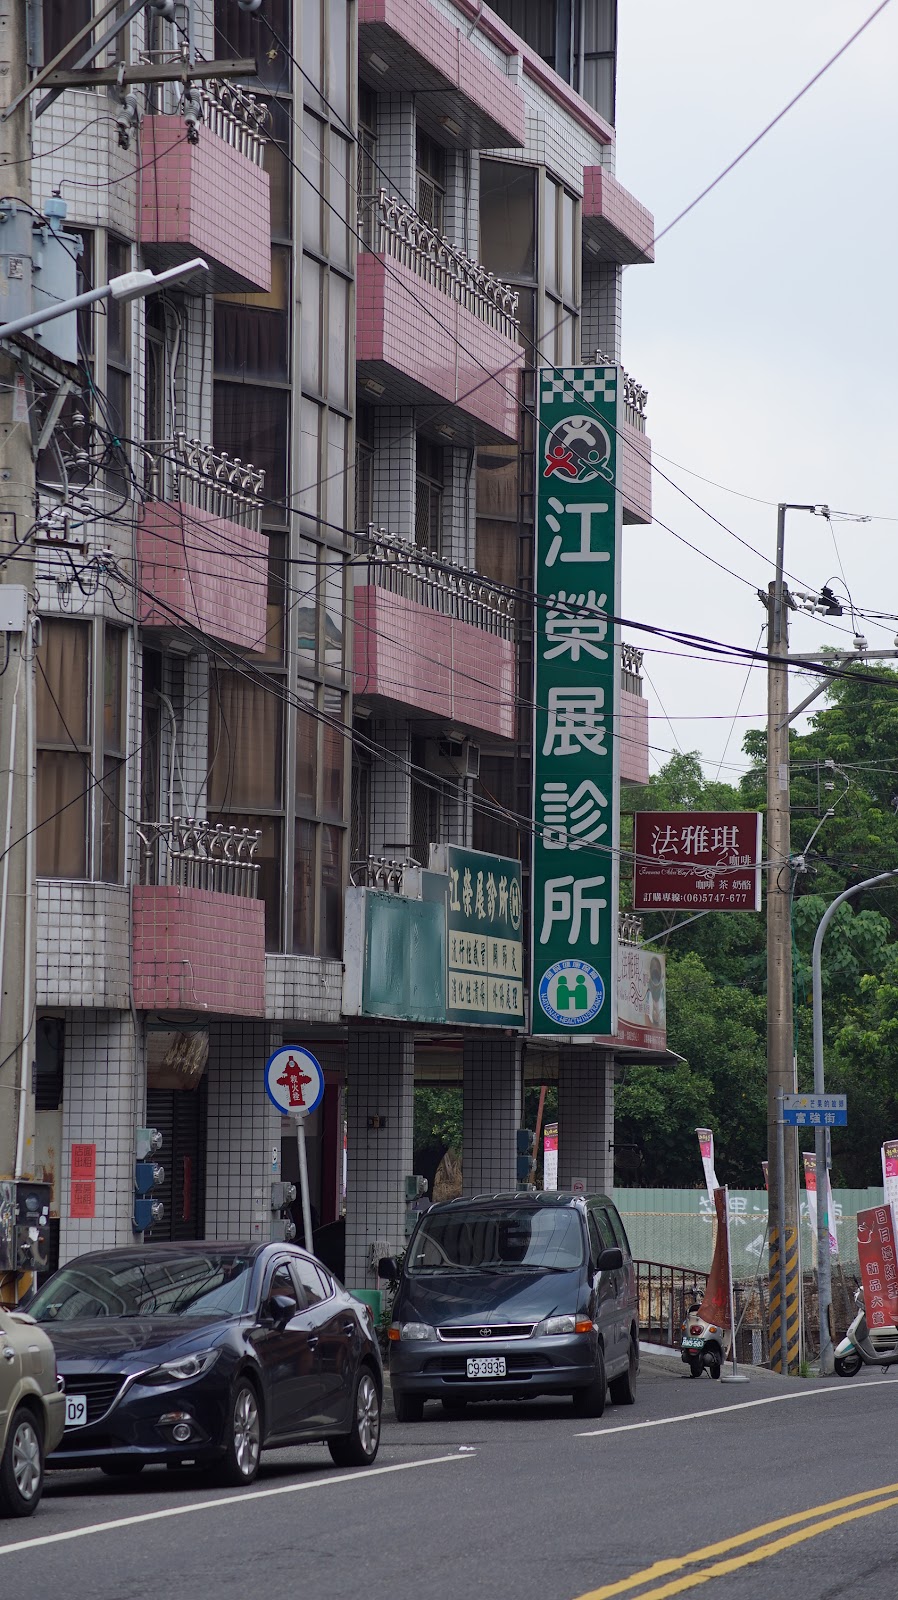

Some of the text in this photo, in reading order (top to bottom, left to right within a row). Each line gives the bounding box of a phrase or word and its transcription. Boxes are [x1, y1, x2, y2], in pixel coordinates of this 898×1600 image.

[540, 496, 611, 945] 江榮展診所
[651, 825, 740, 855] 法雅琪
[729, 855, 751, 866] 咖啡
[695, 880, 751, 890] 咖啡 茶 奶酪
[449, 867, 508, 925] 江榮展診所
[795, 1112, 836, 1124] 富強街
[467, 1361, 505, 1375] C9-3935
